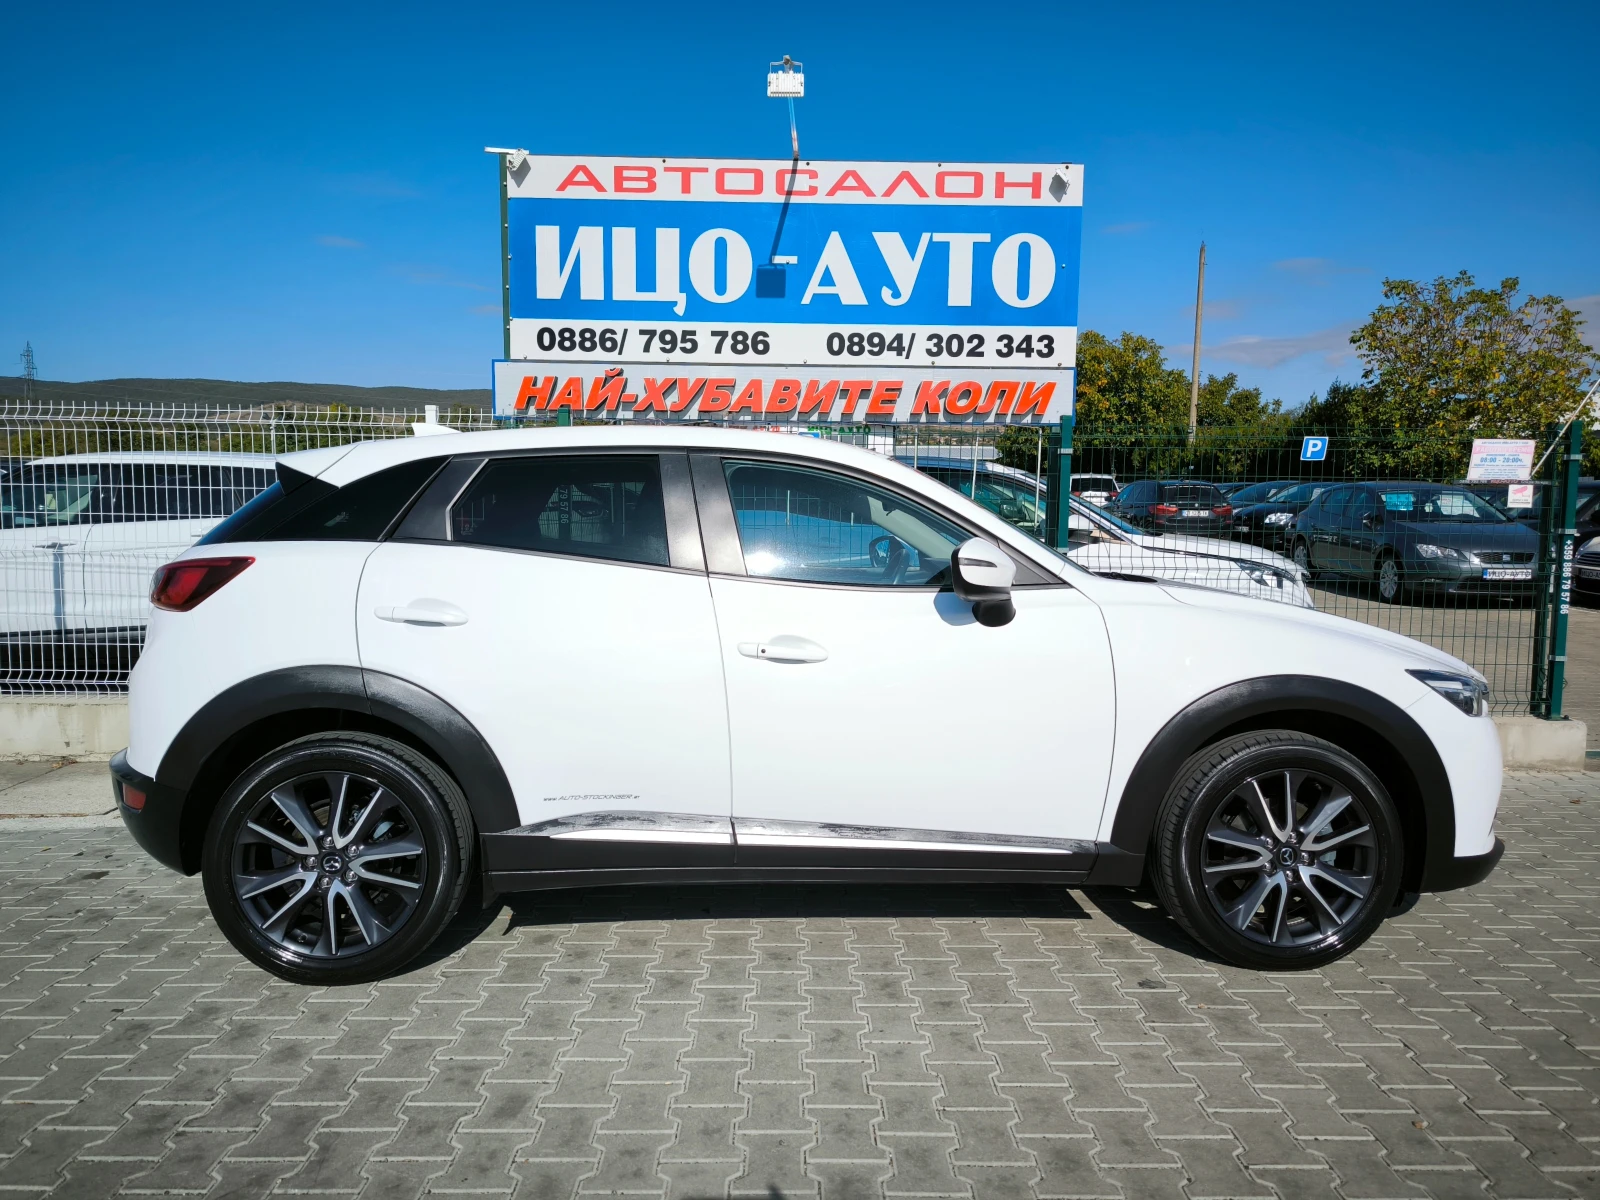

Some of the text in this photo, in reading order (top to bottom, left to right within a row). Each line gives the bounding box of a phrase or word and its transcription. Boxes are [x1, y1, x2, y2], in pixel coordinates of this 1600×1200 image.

[556, 164, 1043, 200] АВТОСАЛОН
[536, 326, 770, 356] 0886/ 795 786
[826, 332, 1055, 359] 0894/ 302 343
[513, 368, 1057, 417] НАЙ-ХУБАВИТЕ КОЛИ
[1306, 440, 1322, 458] P
[1560, 539, 1573, 615] +359 886 79 57 86
